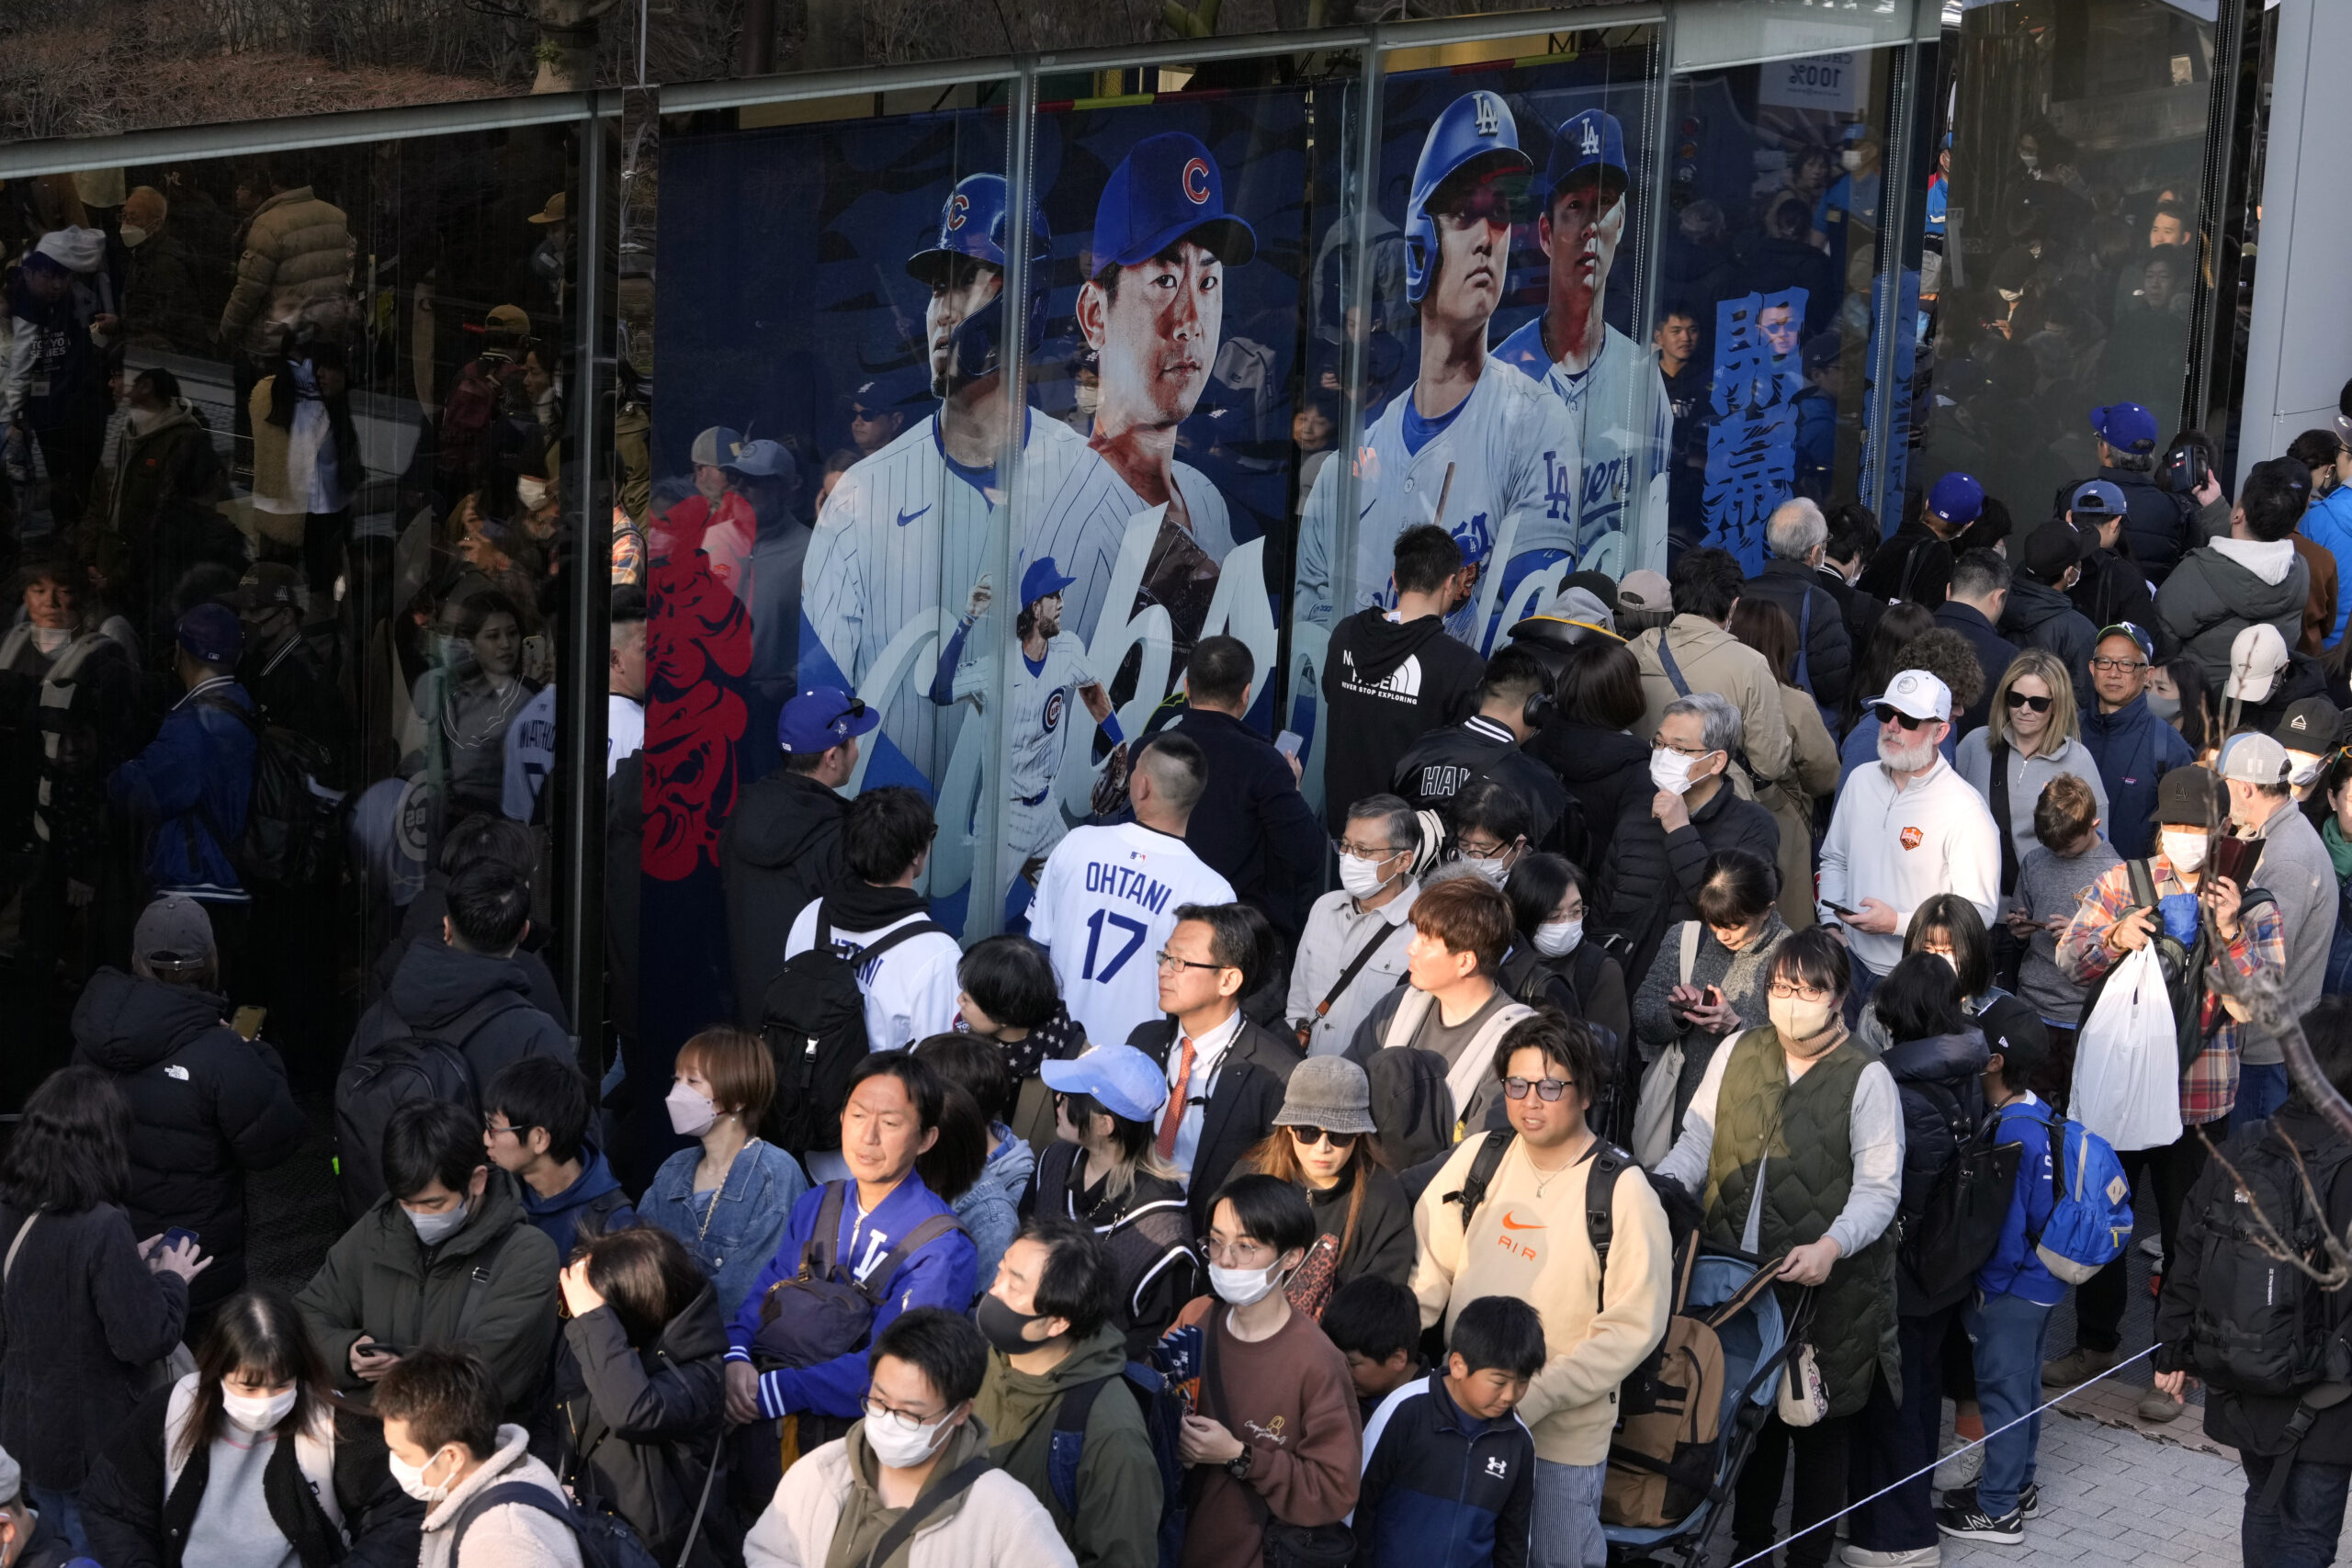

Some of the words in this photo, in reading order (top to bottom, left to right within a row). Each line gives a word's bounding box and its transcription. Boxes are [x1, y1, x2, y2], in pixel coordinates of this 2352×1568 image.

[1472, 93, 1498, 136] LA
[1580, 117, 1600, 155] LA
[1182, 157, 1210, 205] C
[947, 194, 970, 231] C
[1544, 450, 1571, 525] LA
[1341, 681, 1358, 693] NEVER
[1359, 686, 1377, 696] STOP
[1378, 690, 1419, 705] EXPLORING
[1085, 861, 1173, 916] OHTANI
[1081, 908, 1148, 985] 17
[1498, 1235, 1537, 1262] AIR
